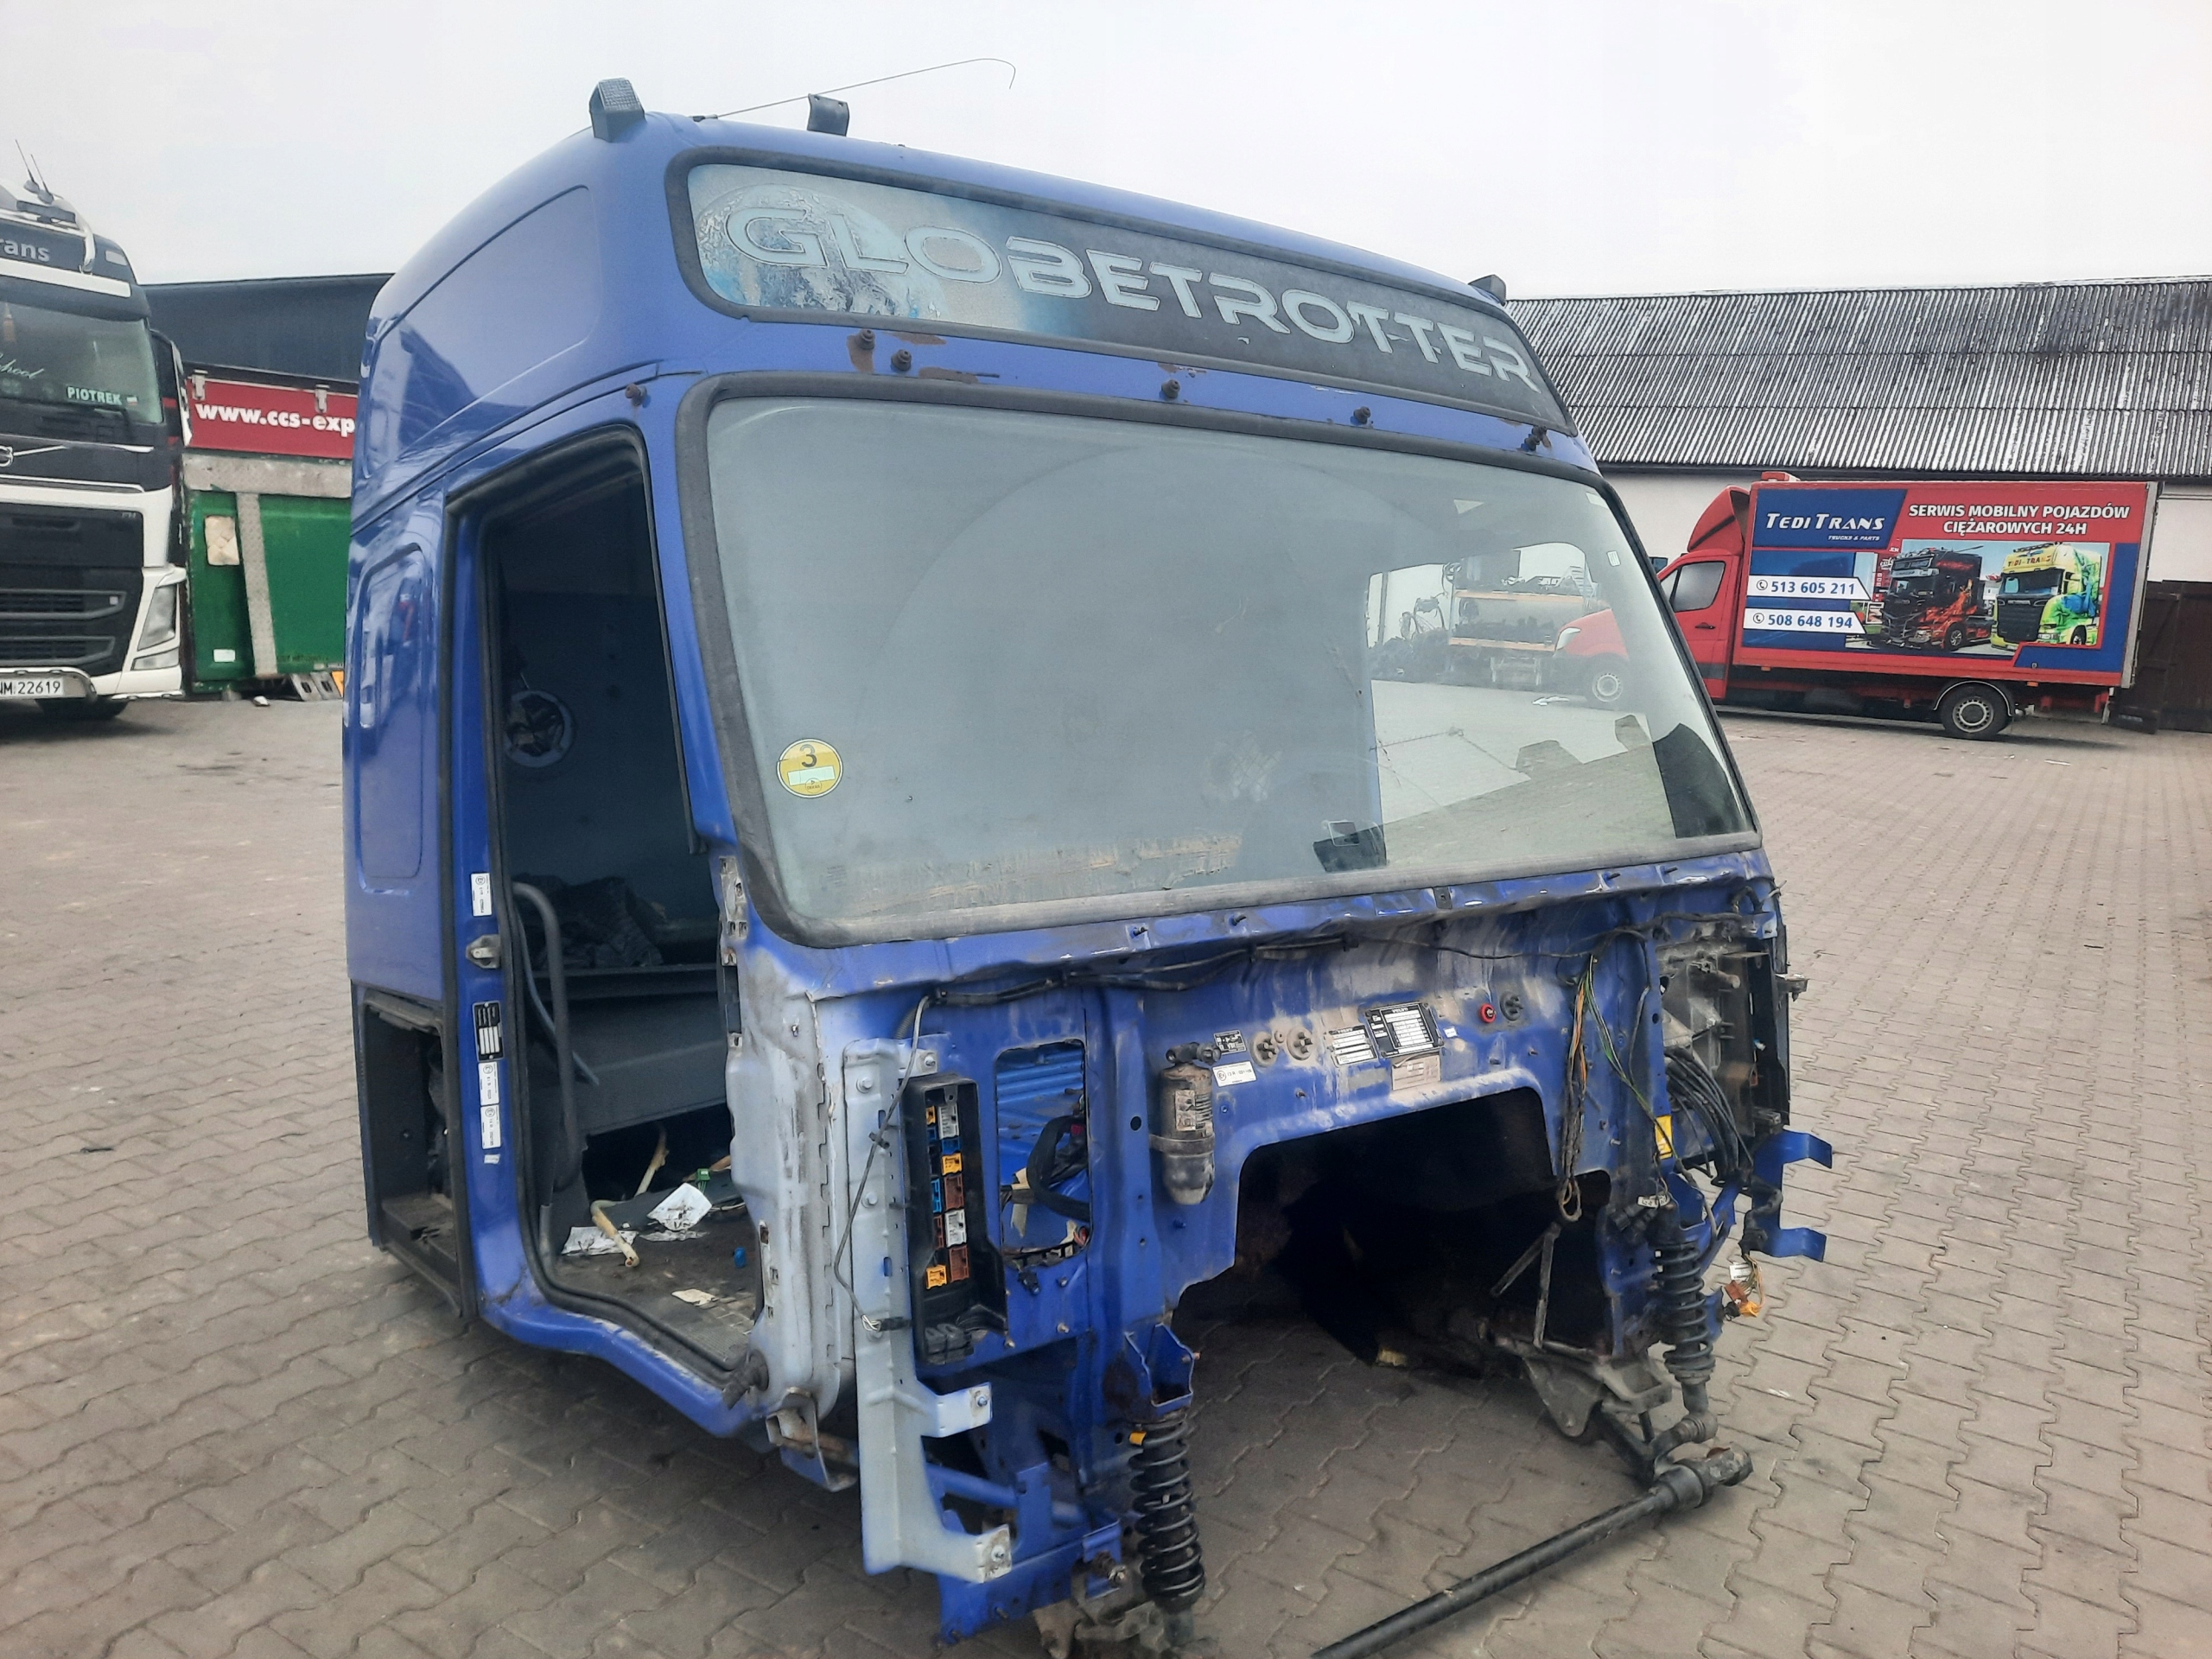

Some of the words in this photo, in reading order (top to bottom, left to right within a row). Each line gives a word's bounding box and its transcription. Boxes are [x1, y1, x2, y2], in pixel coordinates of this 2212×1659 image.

[726, 207, 1541, 394] GLOBETROTTER
[67, 385, 123, 405] PIOTREK
[1908, 505, 1965, 517] SERWIS
[1968, 505, 2038, 518] MOBILNY
[2042, 502, 2130, 519] POJAZDÓW
[1766, 513, 1812, 529] TEDI
[1815, 514, 1885, 530] TRANS
[1943, 518, 2052, 536] CIĘŻAROWYCH
[2056, 522, 2087, 534] 24H
[1771, 581, 1796, 593] 513
[1801, 582, 1825, 594] 605
[1830, 582, 1855, 594] 211
[1768, 614, 1792, 626] 508
[1797, 615, 1821, 626] 648
[1828, 616, 1853, 628] 194
[17, 681, 60, 695] 22619
[799, 744, 817, 767] 3
